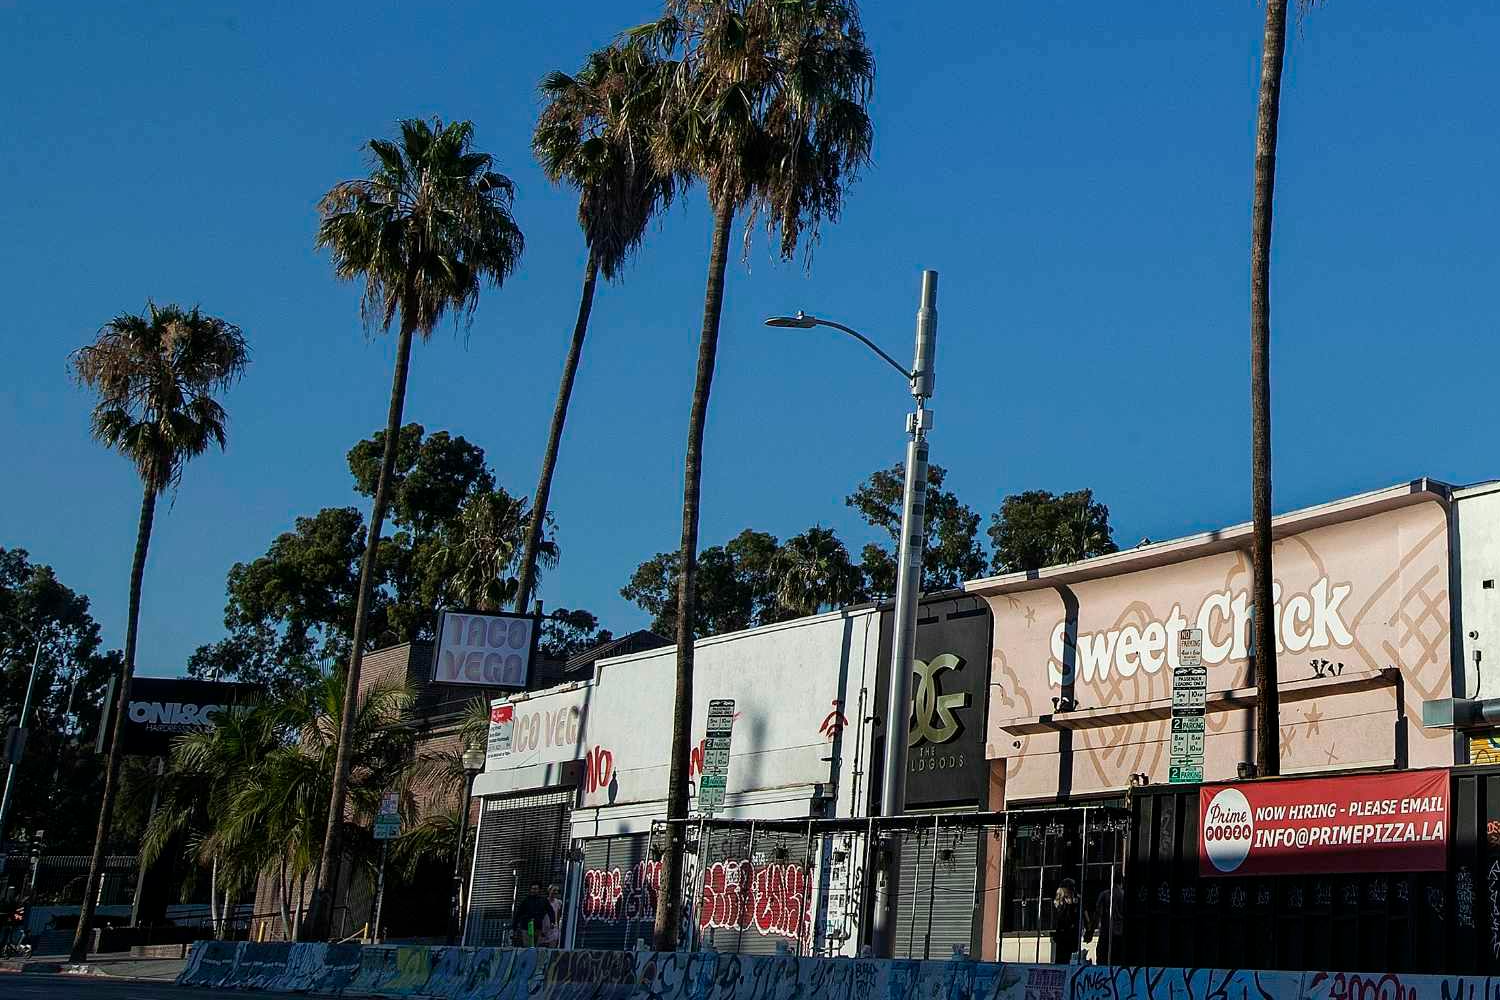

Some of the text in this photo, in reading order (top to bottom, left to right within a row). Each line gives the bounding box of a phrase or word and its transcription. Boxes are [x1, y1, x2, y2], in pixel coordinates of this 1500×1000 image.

[449, 614, 528, 650] TACO
[1181, 630, 1191, 640] NO
[1048, 604, 1186, 688] Sweet
[445, 650, 523, 684] VEGA
[1174, 719, 1180, 729] 2
[920, 746, 936, 757] THE
[586, 745, 614, 794] NO
[911, 755, 966, 773] LDGODS
[1171, 768, 1178, 778] 2
[1209, 803, 1248, 825] Prime
[1255, 805, 1287, 822] NOW
[1288, 802, 1337, 820] HIRING
[1349, 799, 1397, 817] PLEASE
[1400, 796, 1444, 814] EMAIL
[1206, 824, 1251, 841] PIZZA
[1254, 820, 1445, 848] INFO@PRIMEPIZZA.LA
